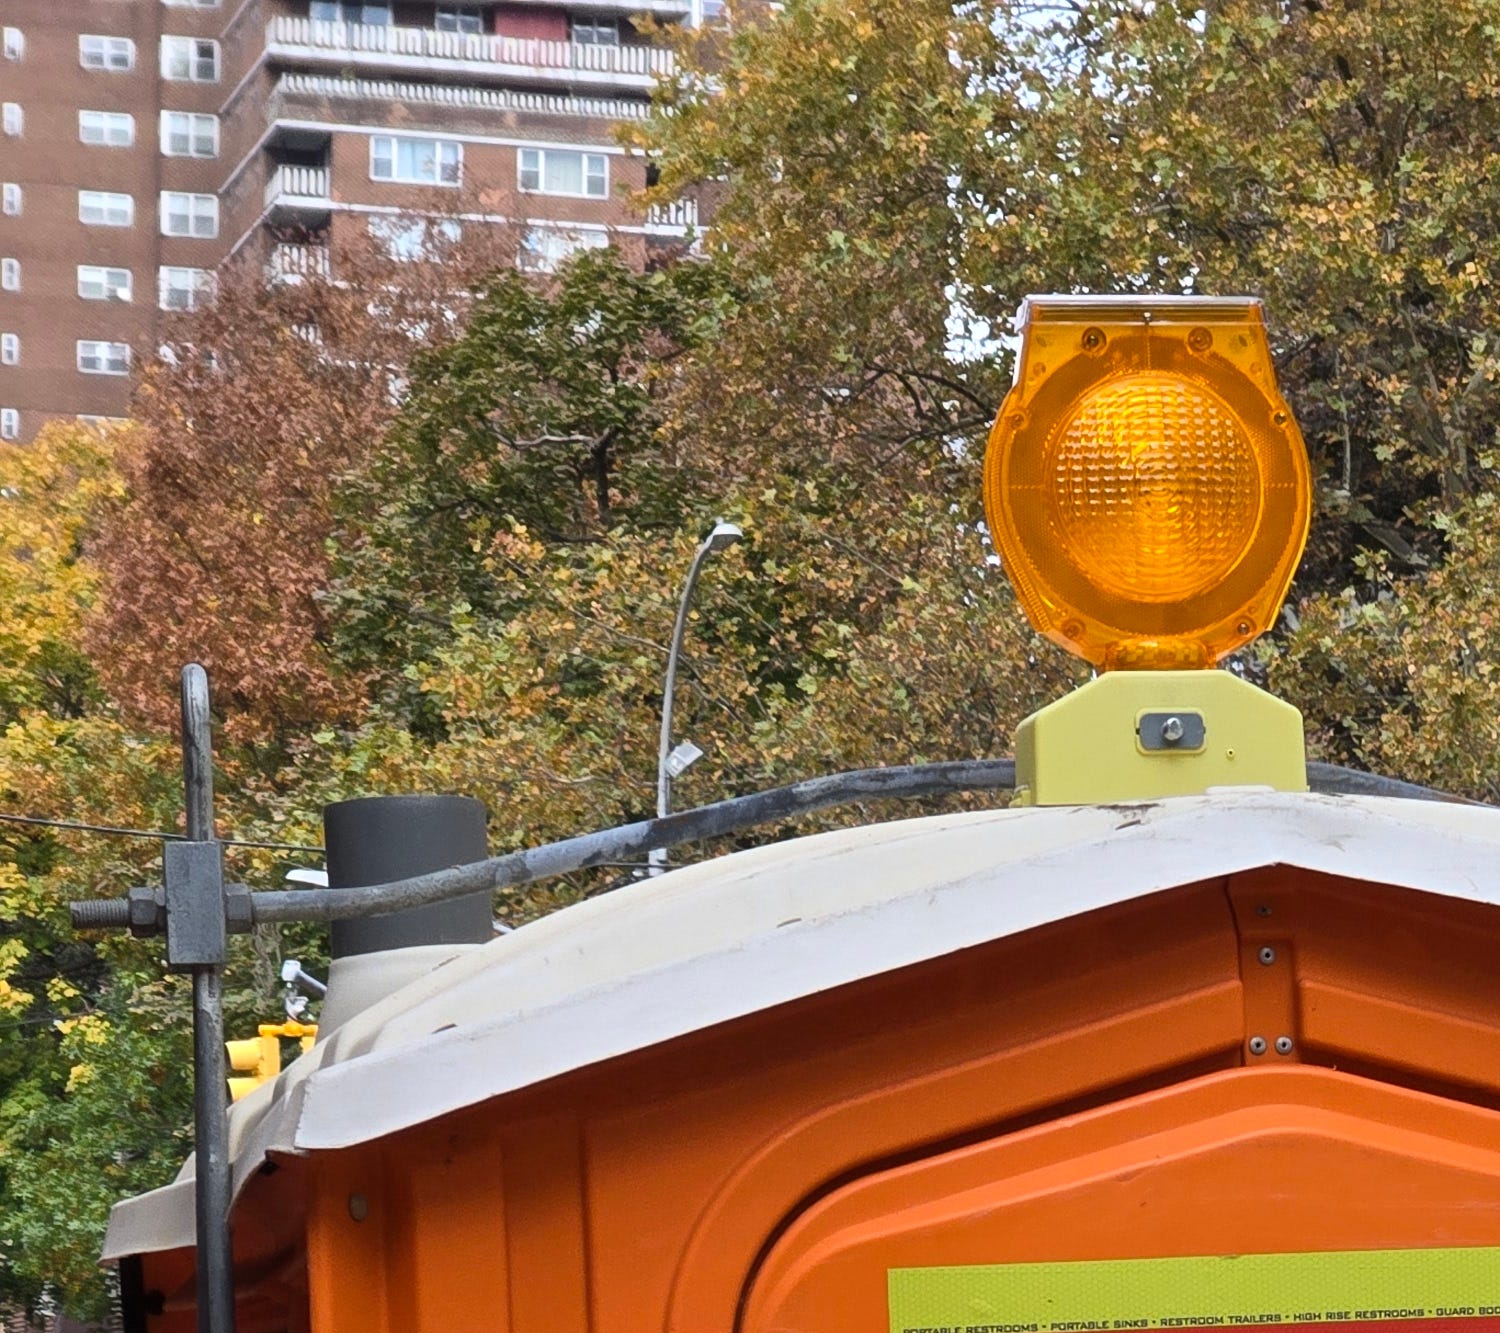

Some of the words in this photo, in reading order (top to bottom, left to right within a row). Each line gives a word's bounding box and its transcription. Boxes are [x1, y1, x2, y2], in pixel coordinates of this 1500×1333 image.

[1050, 1320, 1110, 1332] PORTABLE
[1113, 1319, 1149, 1329] SINKS
[1160, 1316, 1225, 1327] RESTROOM
[1227, 1313, 1282, 1325] TRAILERS
[1293, 1312, 1322, 1322] HIGH
[1325, 1310, 1351, 1321] RISE
[1354, 1308, 1425, 1320] RESTROOMS
[1436, 1306, 1475, 1317] GUARD
